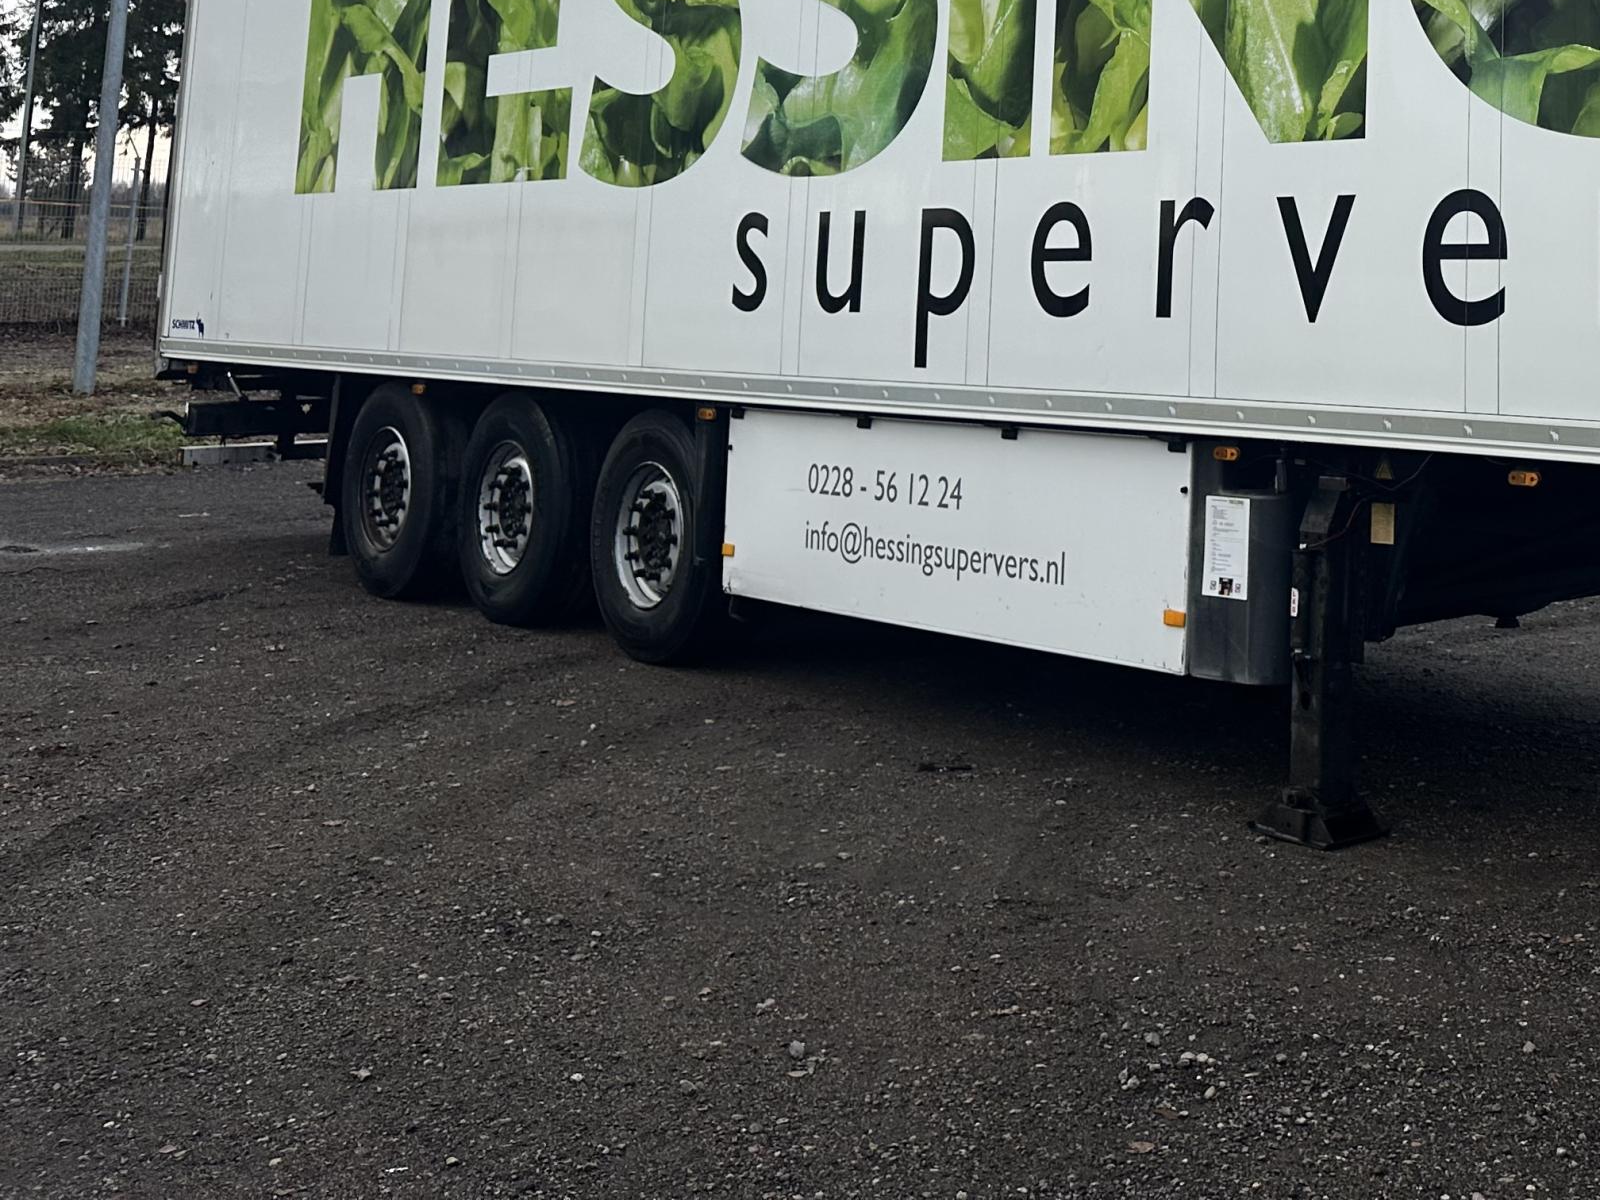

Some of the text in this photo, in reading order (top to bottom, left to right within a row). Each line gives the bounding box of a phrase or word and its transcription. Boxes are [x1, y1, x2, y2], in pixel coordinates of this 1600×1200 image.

[808, 463, 854, 498] 0228
[874, 470, 898, 503] 56
[907, 473, 930, 507] 12
[937, 476, 963, 510] 24
[804, 520, 1066, 586] info@hessingsupervers.nl
